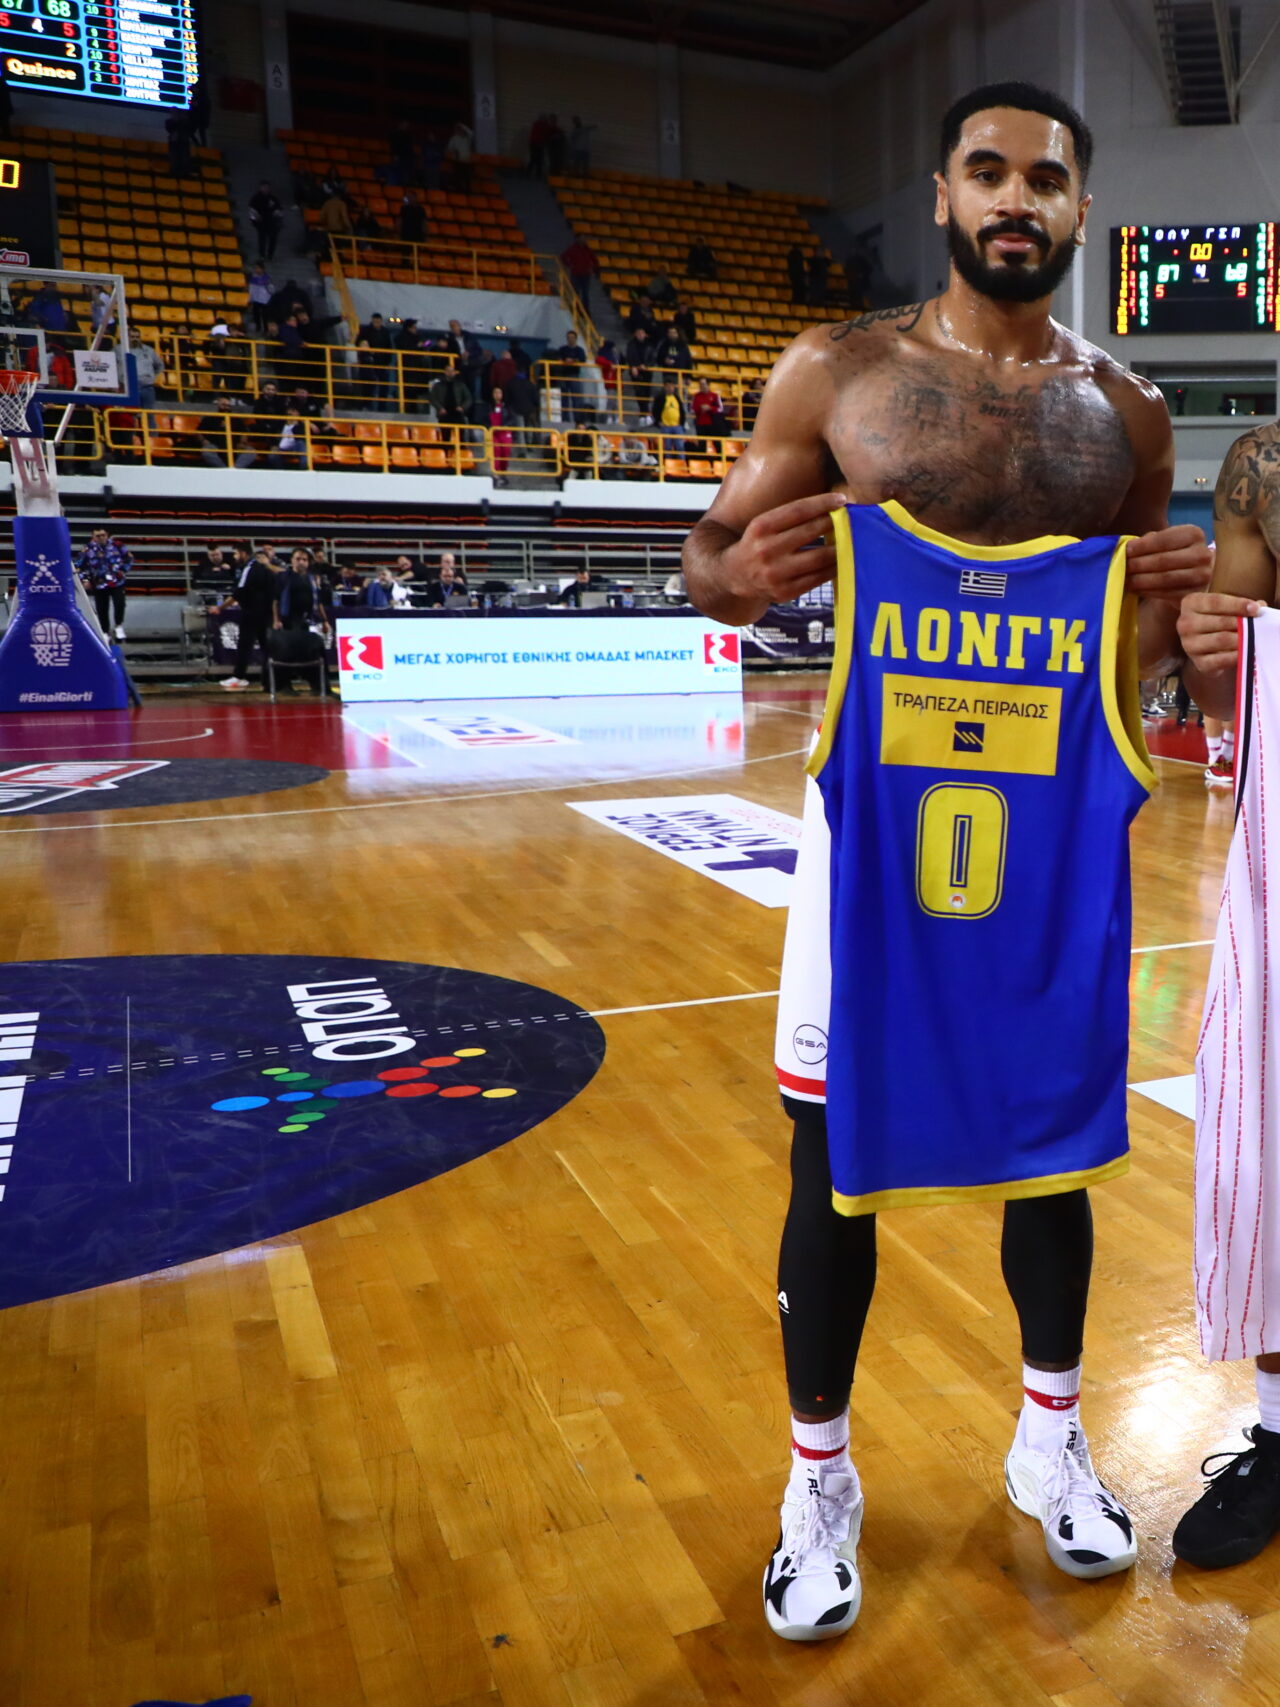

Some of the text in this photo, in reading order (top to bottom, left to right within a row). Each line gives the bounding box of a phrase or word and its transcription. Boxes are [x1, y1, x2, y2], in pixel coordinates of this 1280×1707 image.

[86, 5, 99, 15] 10
[32, 18, 43, 33] 4
[63, 22, 75, 37] 5
[65, 43, 77, 57] 2
[90, 50, 103, 60] 10
[7, 58, 77, 81] Quince
[1157, 262, 1248, 283] 87 4 68
[1155, 282, 1247, 298] 5 5
[869, 601, 1087, 674] ΛΟΝΓΚ
[394, 649, 694, 665] ΜΕΓΑΣ ΧΟΡΗΓΟΣ ΕΘΝΙΚΗΣ ΟΜΑΔΑΣ ΜΠΑΣΚΕΤ
[19, 691, 93, 703] #EinaiGiorti
[893, 691, 1049, 720] ΤΡΑΠΕΖΑ ΠΕΙΡΑΙΩΣ
[915, 781, 1009, 920] 0
[795, 1037, 827, 1049] GSA
